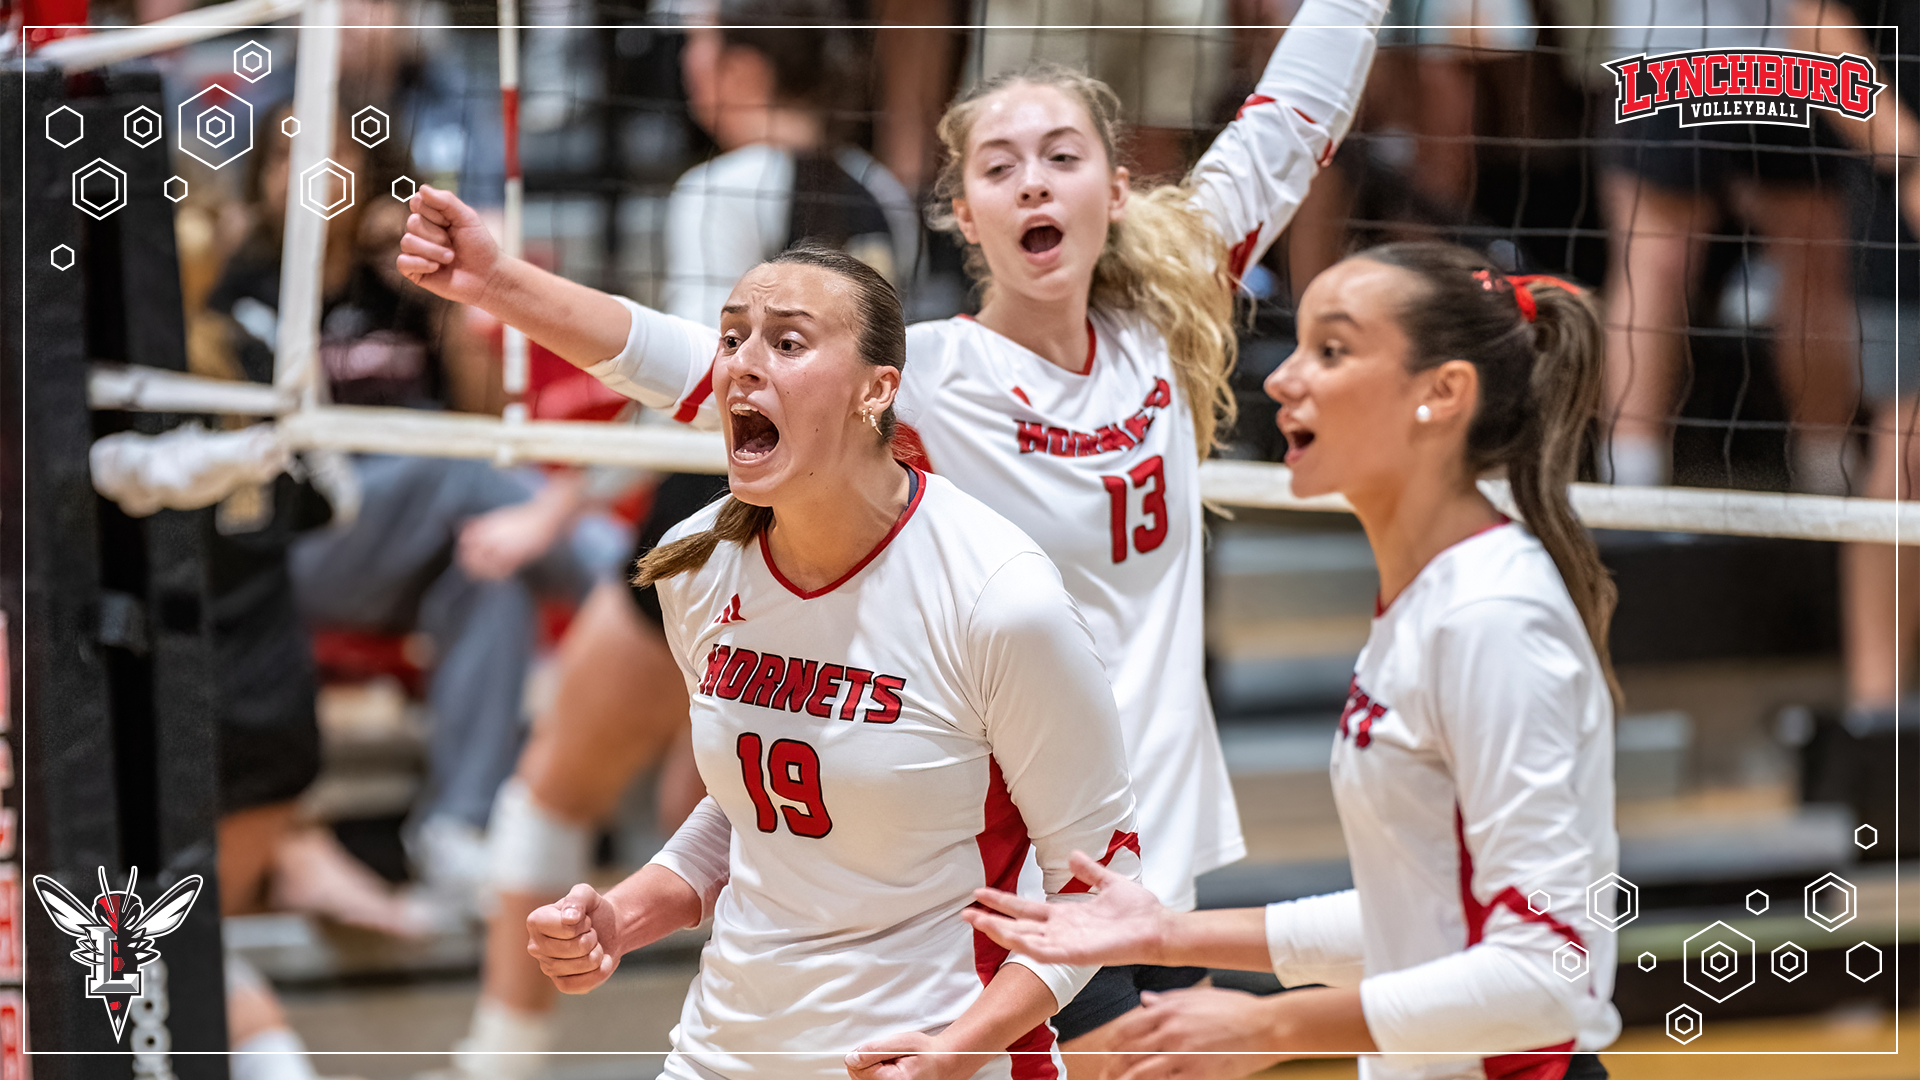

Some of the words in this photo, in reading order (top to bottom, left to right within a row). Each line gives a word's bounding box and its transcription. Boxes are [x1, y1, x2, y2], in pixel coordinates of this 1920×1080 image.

[1013, 374, 1171, 458] HORNES
[1100, 455, 1168, 564] 13
[699, 643, 907, 724] HORNETS
[736, 732, 833, 839] 19
